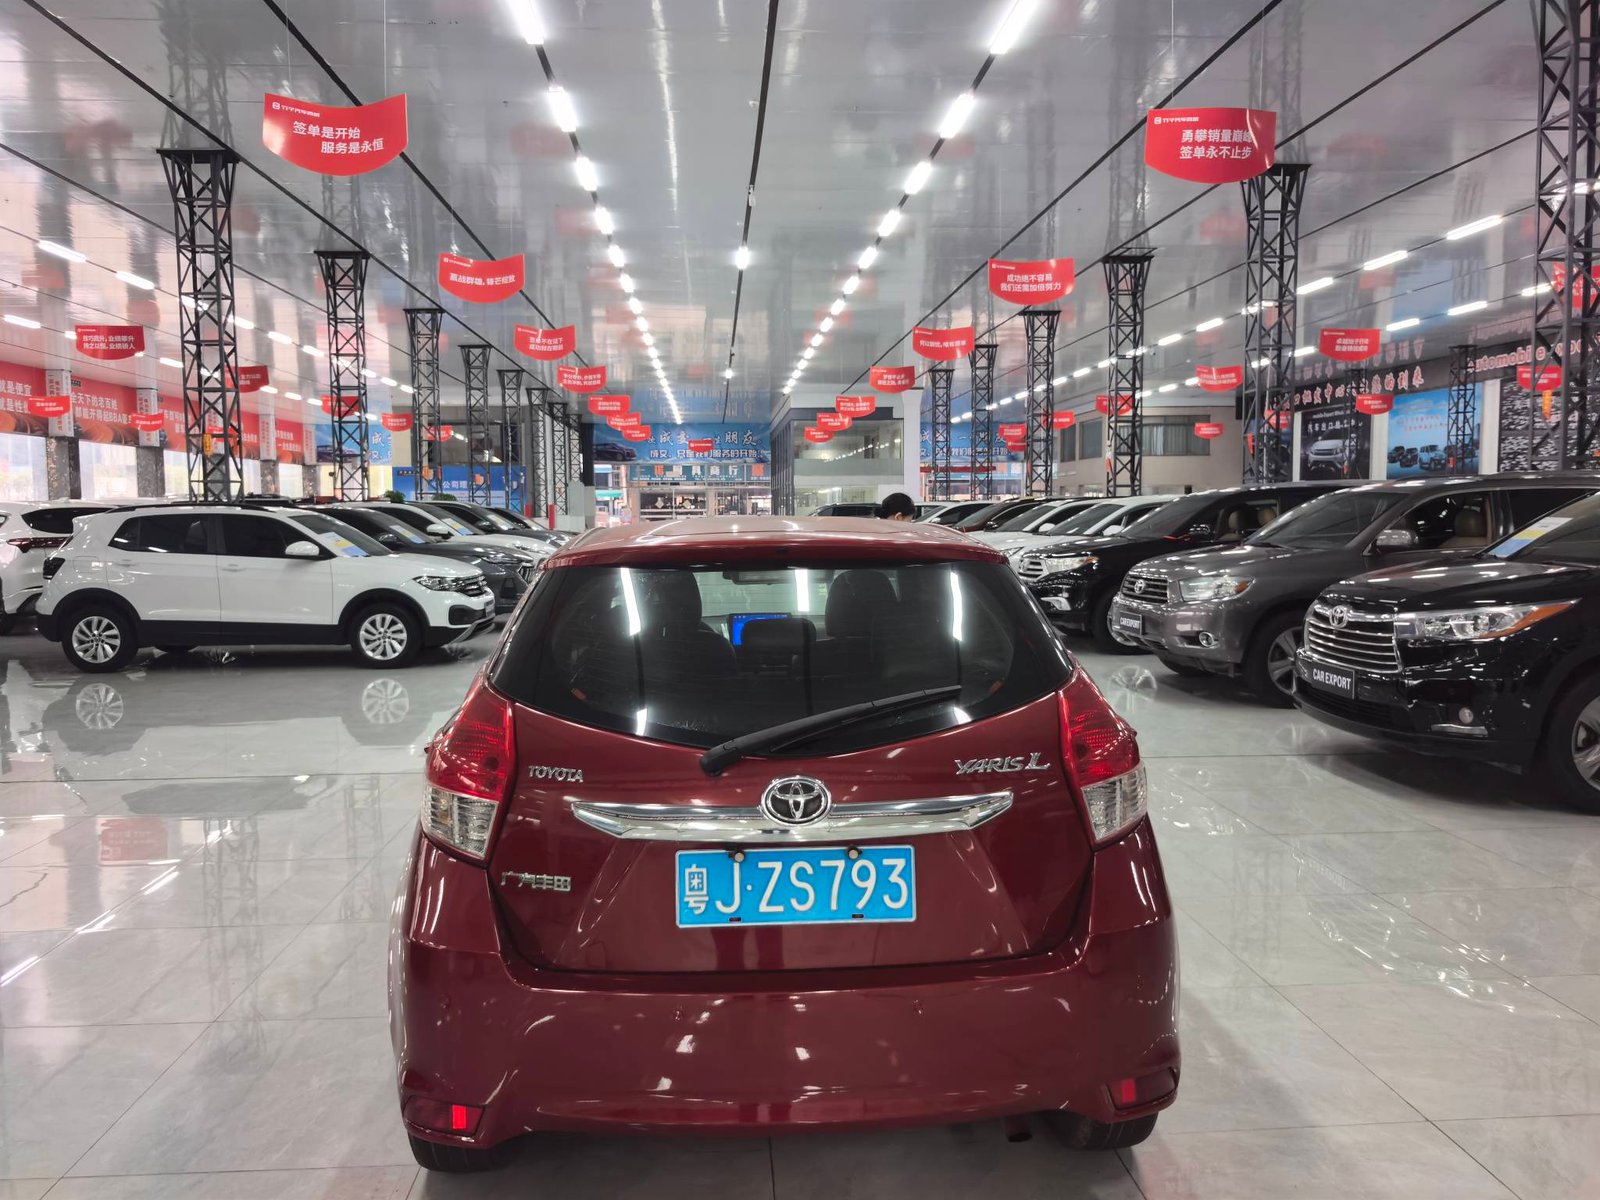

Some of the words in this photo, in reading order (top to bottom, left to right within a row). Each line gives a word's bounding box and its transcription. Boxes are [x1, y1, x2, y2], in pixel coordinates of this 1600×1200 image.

[293, 120, 361, 139] 签单是开始
[1181, 129, 1253, 142] 勇攀销量巅峰
[321, 138, 384, 154] 服务是永恒
[1180, 146, 1252, 159] 签单永不止步
[1312, 668, 1325, 682] CAR
[1325, 671, 1352, 690] EXPORT
[954, 756, 1025, 775] YARIS
[1025, 752, 1051, 770] L
[528, 765, 584, 783] TOYOTA
[500, 871, 572, 892] 广汽丰田
